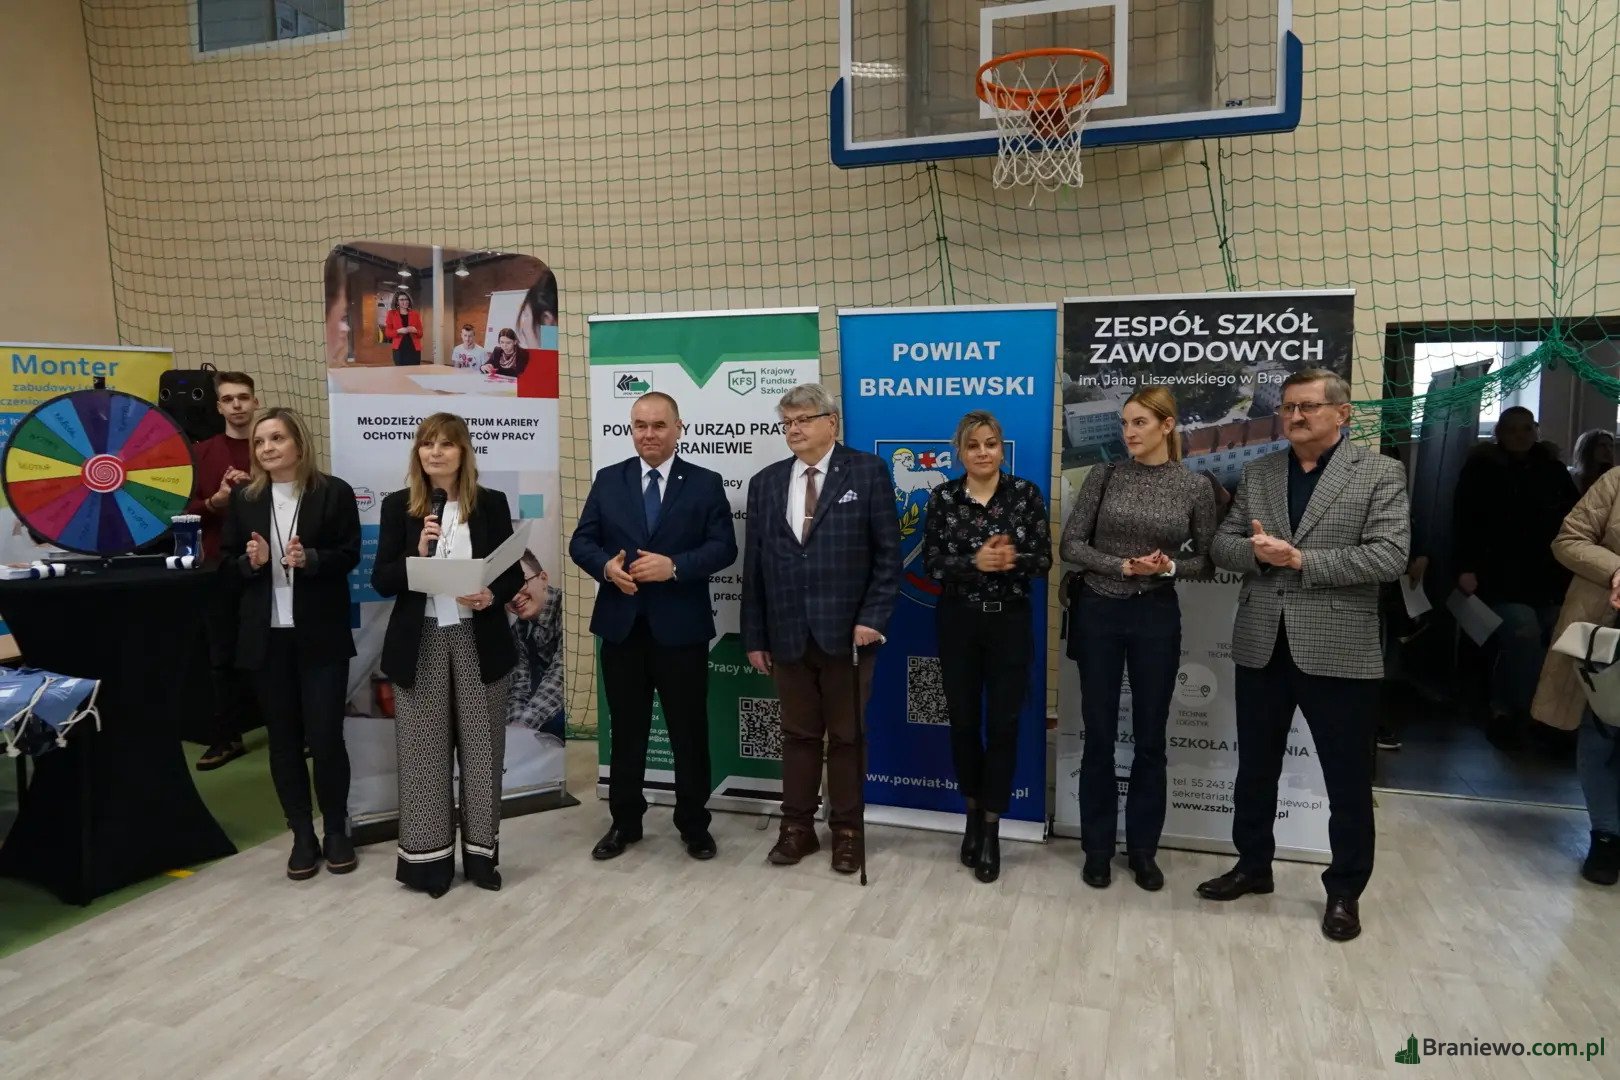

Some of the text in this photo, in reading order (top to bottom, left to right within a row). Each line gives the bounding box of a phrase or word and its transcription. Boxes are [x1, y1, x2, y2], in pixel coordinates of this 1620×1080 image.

[1095, 307, 1319, 338] ZESPÓŁ SZKÓŁ
[892, 341, 1001, 362] POWIAT
[1089, 339, 1324, 364] ZAWODOWYCH
[12, 353, 119, 377] Monter
[760, 367, 795, 376] Krajowy
[731, 376, 752, 386] KFS
[860, 376, 1035, 397] BRANIEWSKI
[1079, 374, 1100, 386] im.
[1103, 374, 1137, 386] Jana
[1141, 372, 1236, 389] Liszewskiego
[1241, 374, 1253, 384] w
[760, 386, 792, 395] Szkole
[357, 415, 540, 427] MŁODZIEŻO TRUM KARIERY
[363, 430, 536, 441] OCHOTNI FCÓW PRACY
[694, 422, 745, 438] URZĄD
[1169, 736, 1229, 751] SZKOŁA
[1191, 778, 1204, 788] 55
[1206, 779, 1225, 790] 243
